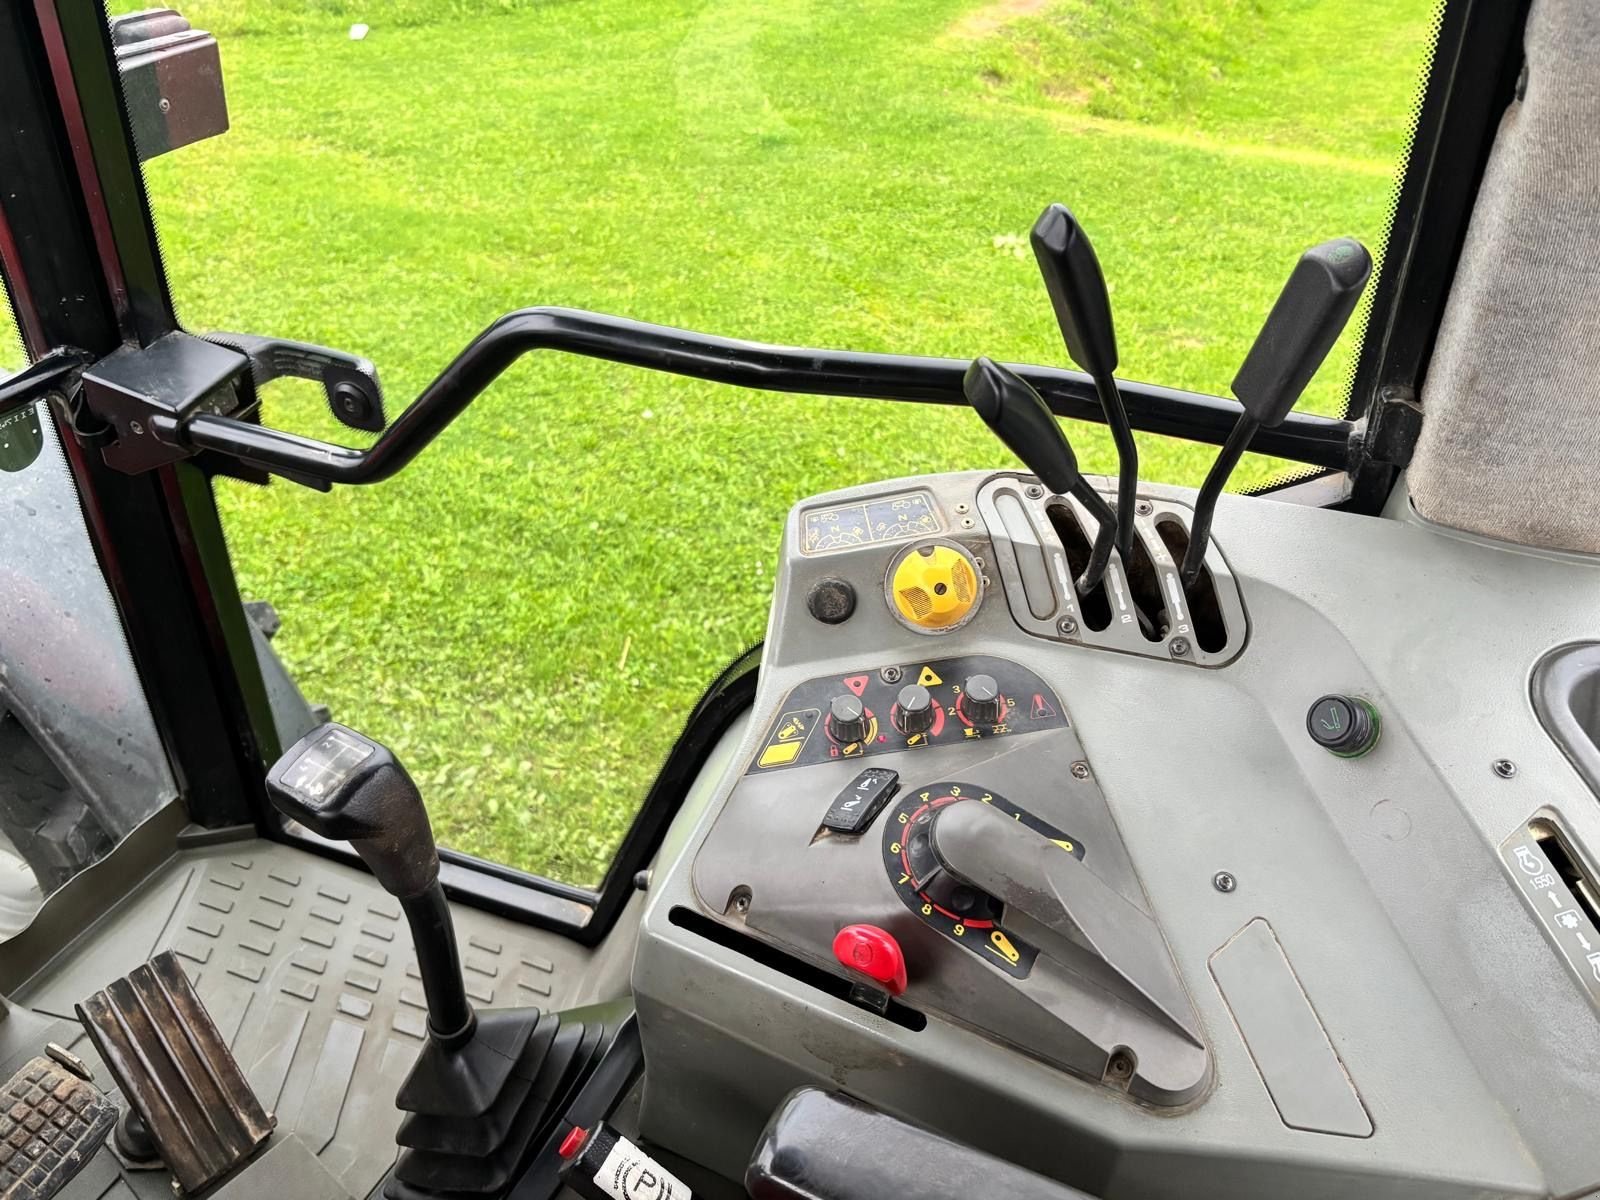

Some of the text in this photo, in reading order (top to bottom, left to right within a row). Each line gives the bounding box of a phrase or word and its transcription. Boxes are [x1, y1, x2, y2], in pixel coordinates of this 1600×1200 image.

[1066, 603, 1075, 613] 1
[1121, 614, 1133, 624] 2
[1178, 624, 1189, 634] 3
[952, 685, 961, 694] 3
[1006, 698, 1016, 707] 5
[947, 707, 957, 716] 2
[919, 791, 930, 802] 4
[950, 786, 961, 797] 3
[981, 793, 993, 803] 2
[897, 813, 909, 823] 5
[1013, 813, 1022, 821] 1
[890, 842, 901, 854] 6
[898, 872, 910, 885] 7
[1529, 873, 1556, 890] 1550
[921, 903, 933, 915] 8
[953, 924, 965, 936] 9
